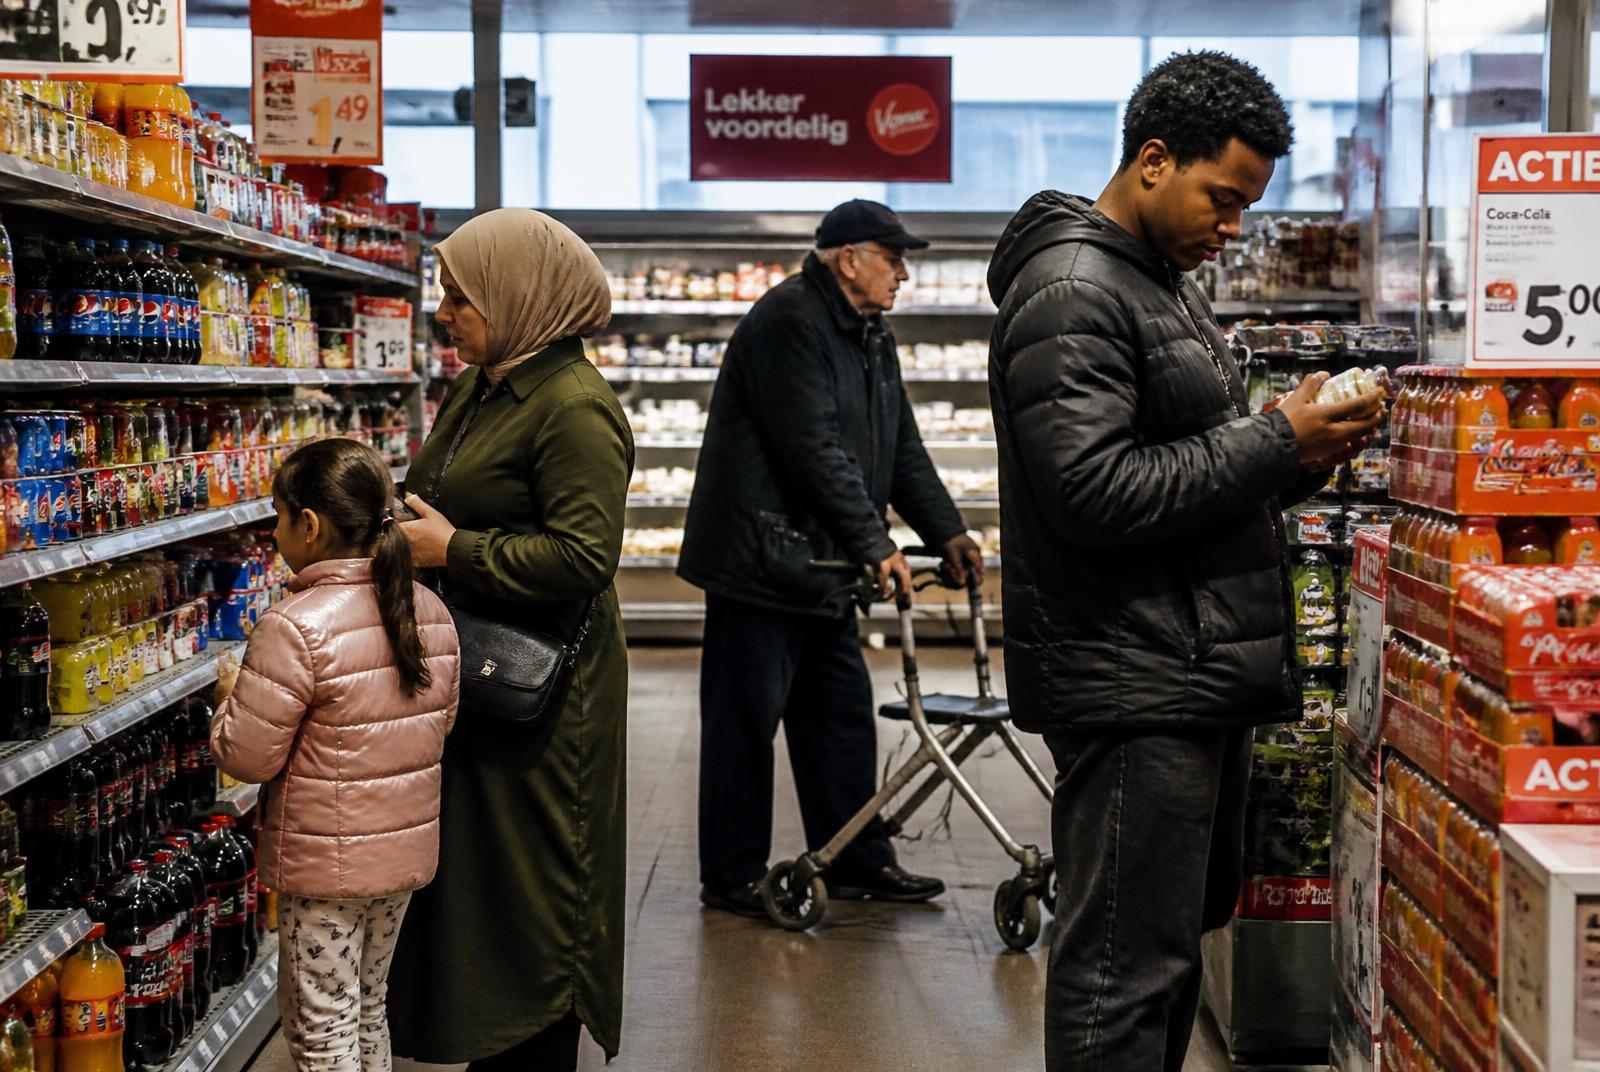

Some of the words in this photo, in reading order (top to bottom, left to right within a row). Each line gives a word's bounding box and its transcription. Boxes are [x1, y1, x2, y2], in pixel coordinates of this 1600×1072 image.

[705, 88, 805, 113] Lekker
[705, 114, 848, 145] voordelig
[1487, 150, 1600, 182] ACTIE
